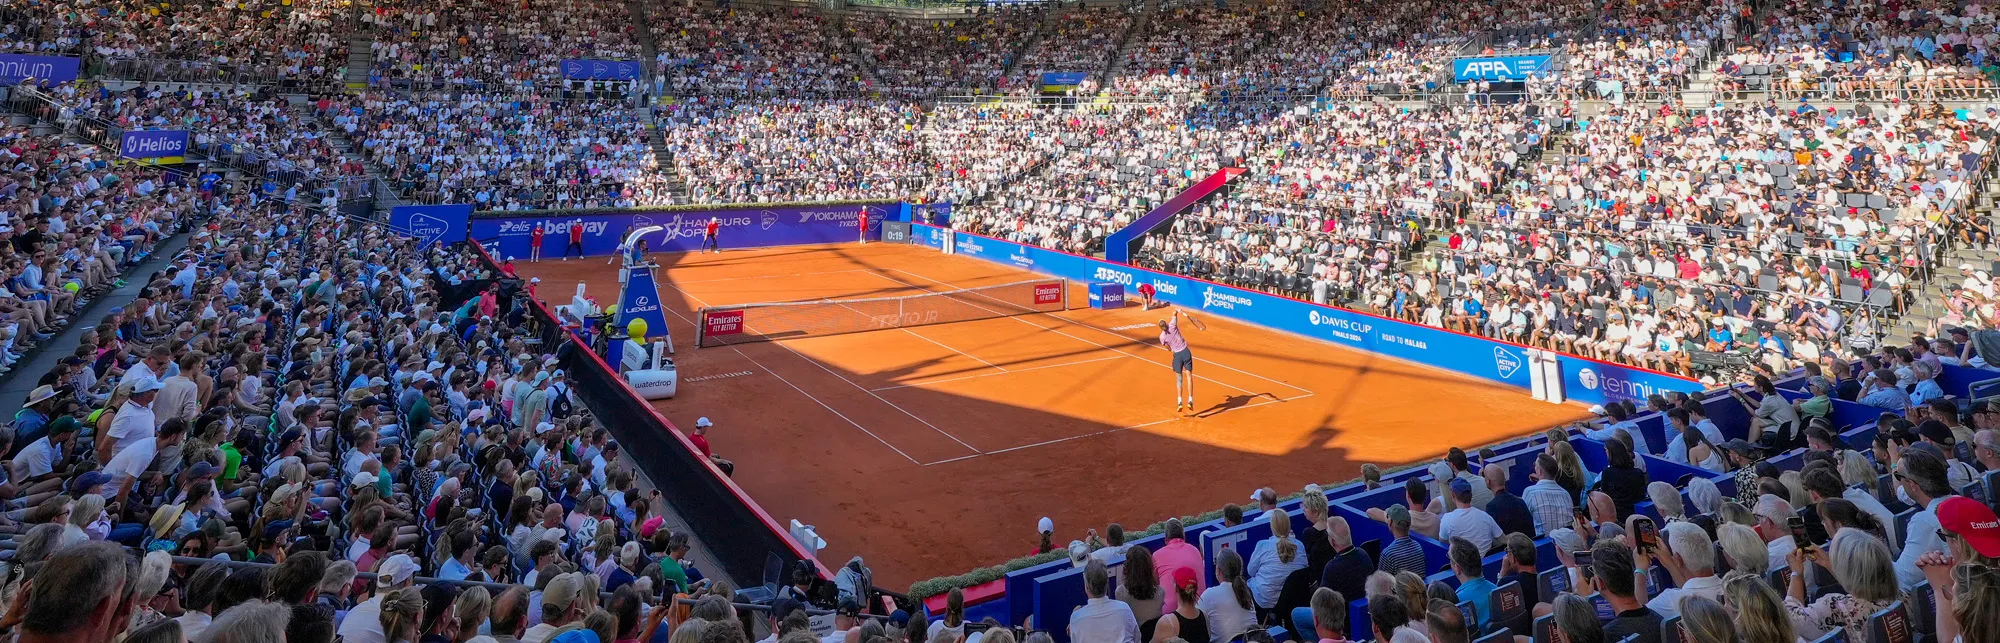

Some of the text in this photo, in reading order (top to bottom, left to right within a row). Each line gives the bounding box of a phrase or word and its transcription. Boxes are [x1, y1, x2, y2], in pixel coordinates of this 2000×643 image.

[1462, 61, 1513, 76] APA
[139, 137, 182, 152] Helios
[813, 211, 859, 221] YOKOHAMA
[511, 221, 531, 232] elis
[887, 231, 904, 240] 0:19
[1035, 287, 1060, 296] Emirates
[1153, 278, 1177, 295] Haier
[1103, 293, 1123, 302] Haier
[1213, 292, 1252, 306] HAMBURG
[626, 305, 658, 313] LEXUS
[1214, 299, 1234, 310] OPEN
[708, 315, 742, 326] Emirates
[1322, 315, 1371, 333] DAVIS CUP
[1396, 336, 1404, 344] TO
[1498, 358, 1517, 368] ACTIVE
[1499, 364, 1511, 372] CITY
[685, 370, 753, 382] HAMBURG
[634, 380, 672, 389] waterdrop
